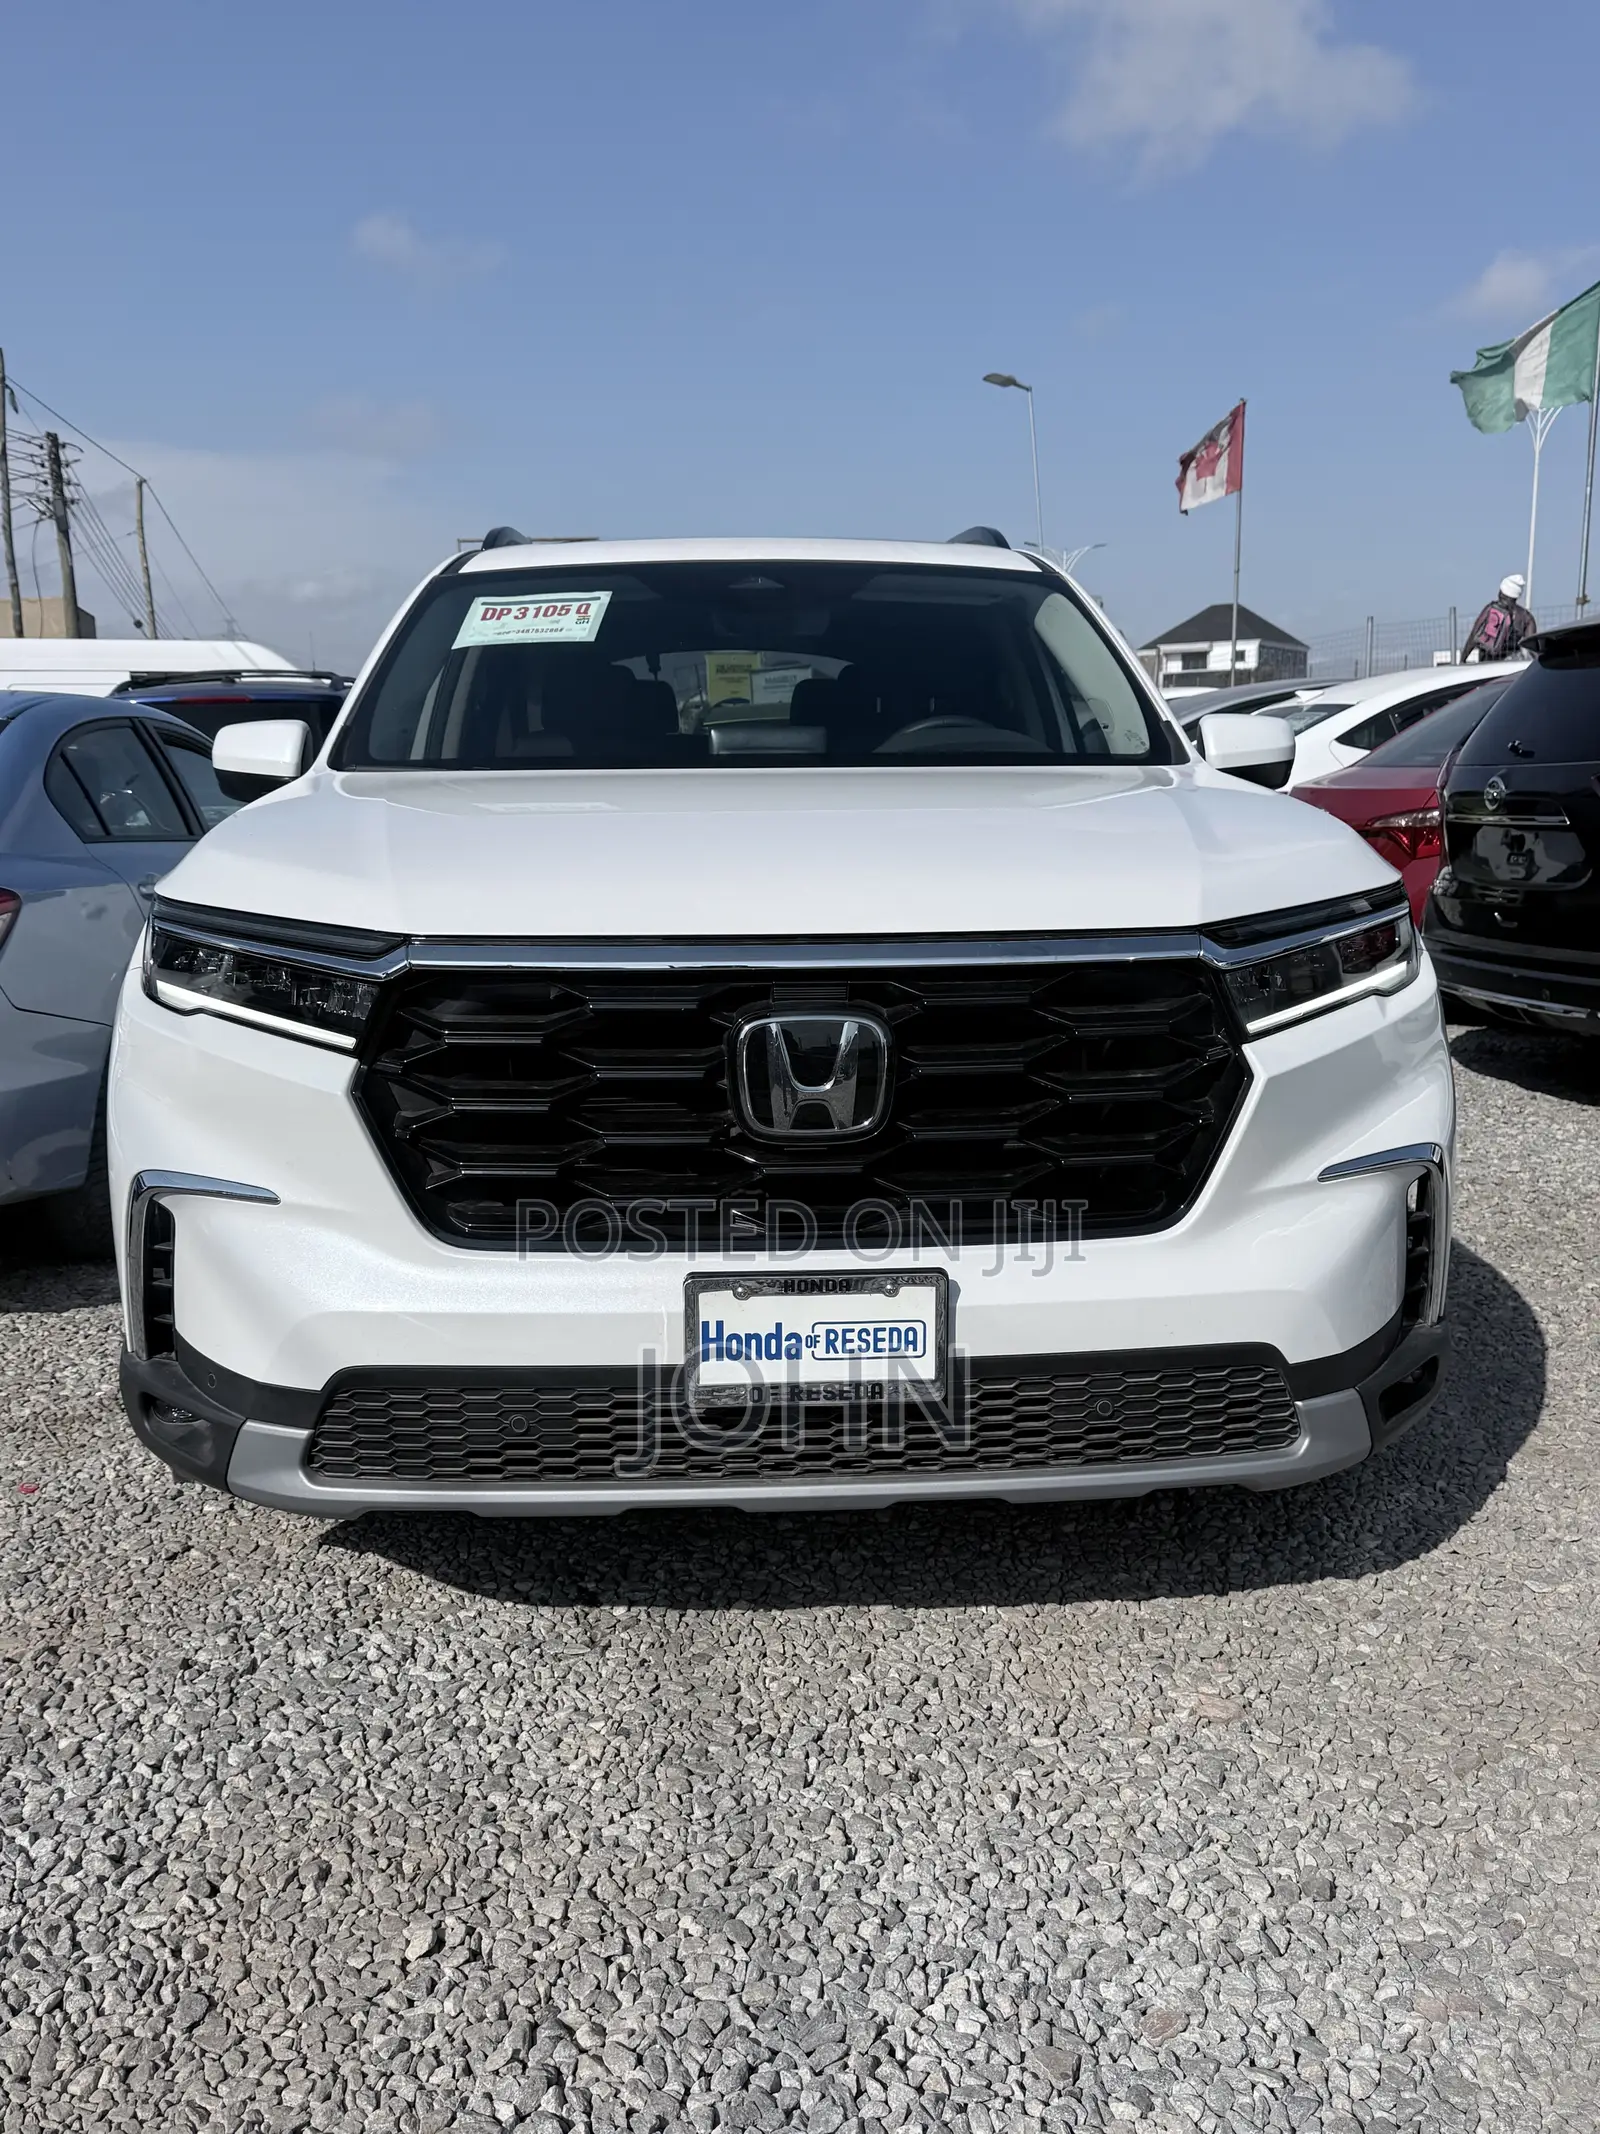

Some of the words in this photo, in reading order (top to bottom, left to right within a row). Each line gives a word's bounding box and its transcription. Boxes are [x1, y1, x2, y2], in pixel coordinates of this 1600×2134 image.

[480, 606, 512, 621] DP
[513, 604, 573, 620] 3105
[783, 1278, 851, 1293] HONDA
[701, 1320, 803, 1362] Honda
[805, 1333, 821, 1349] OF
[824, 1326, 918, 1355] RESEDA
[749, 1385, 781, 1403] OF
[789, 1383, 884, 1403] RESEDA
